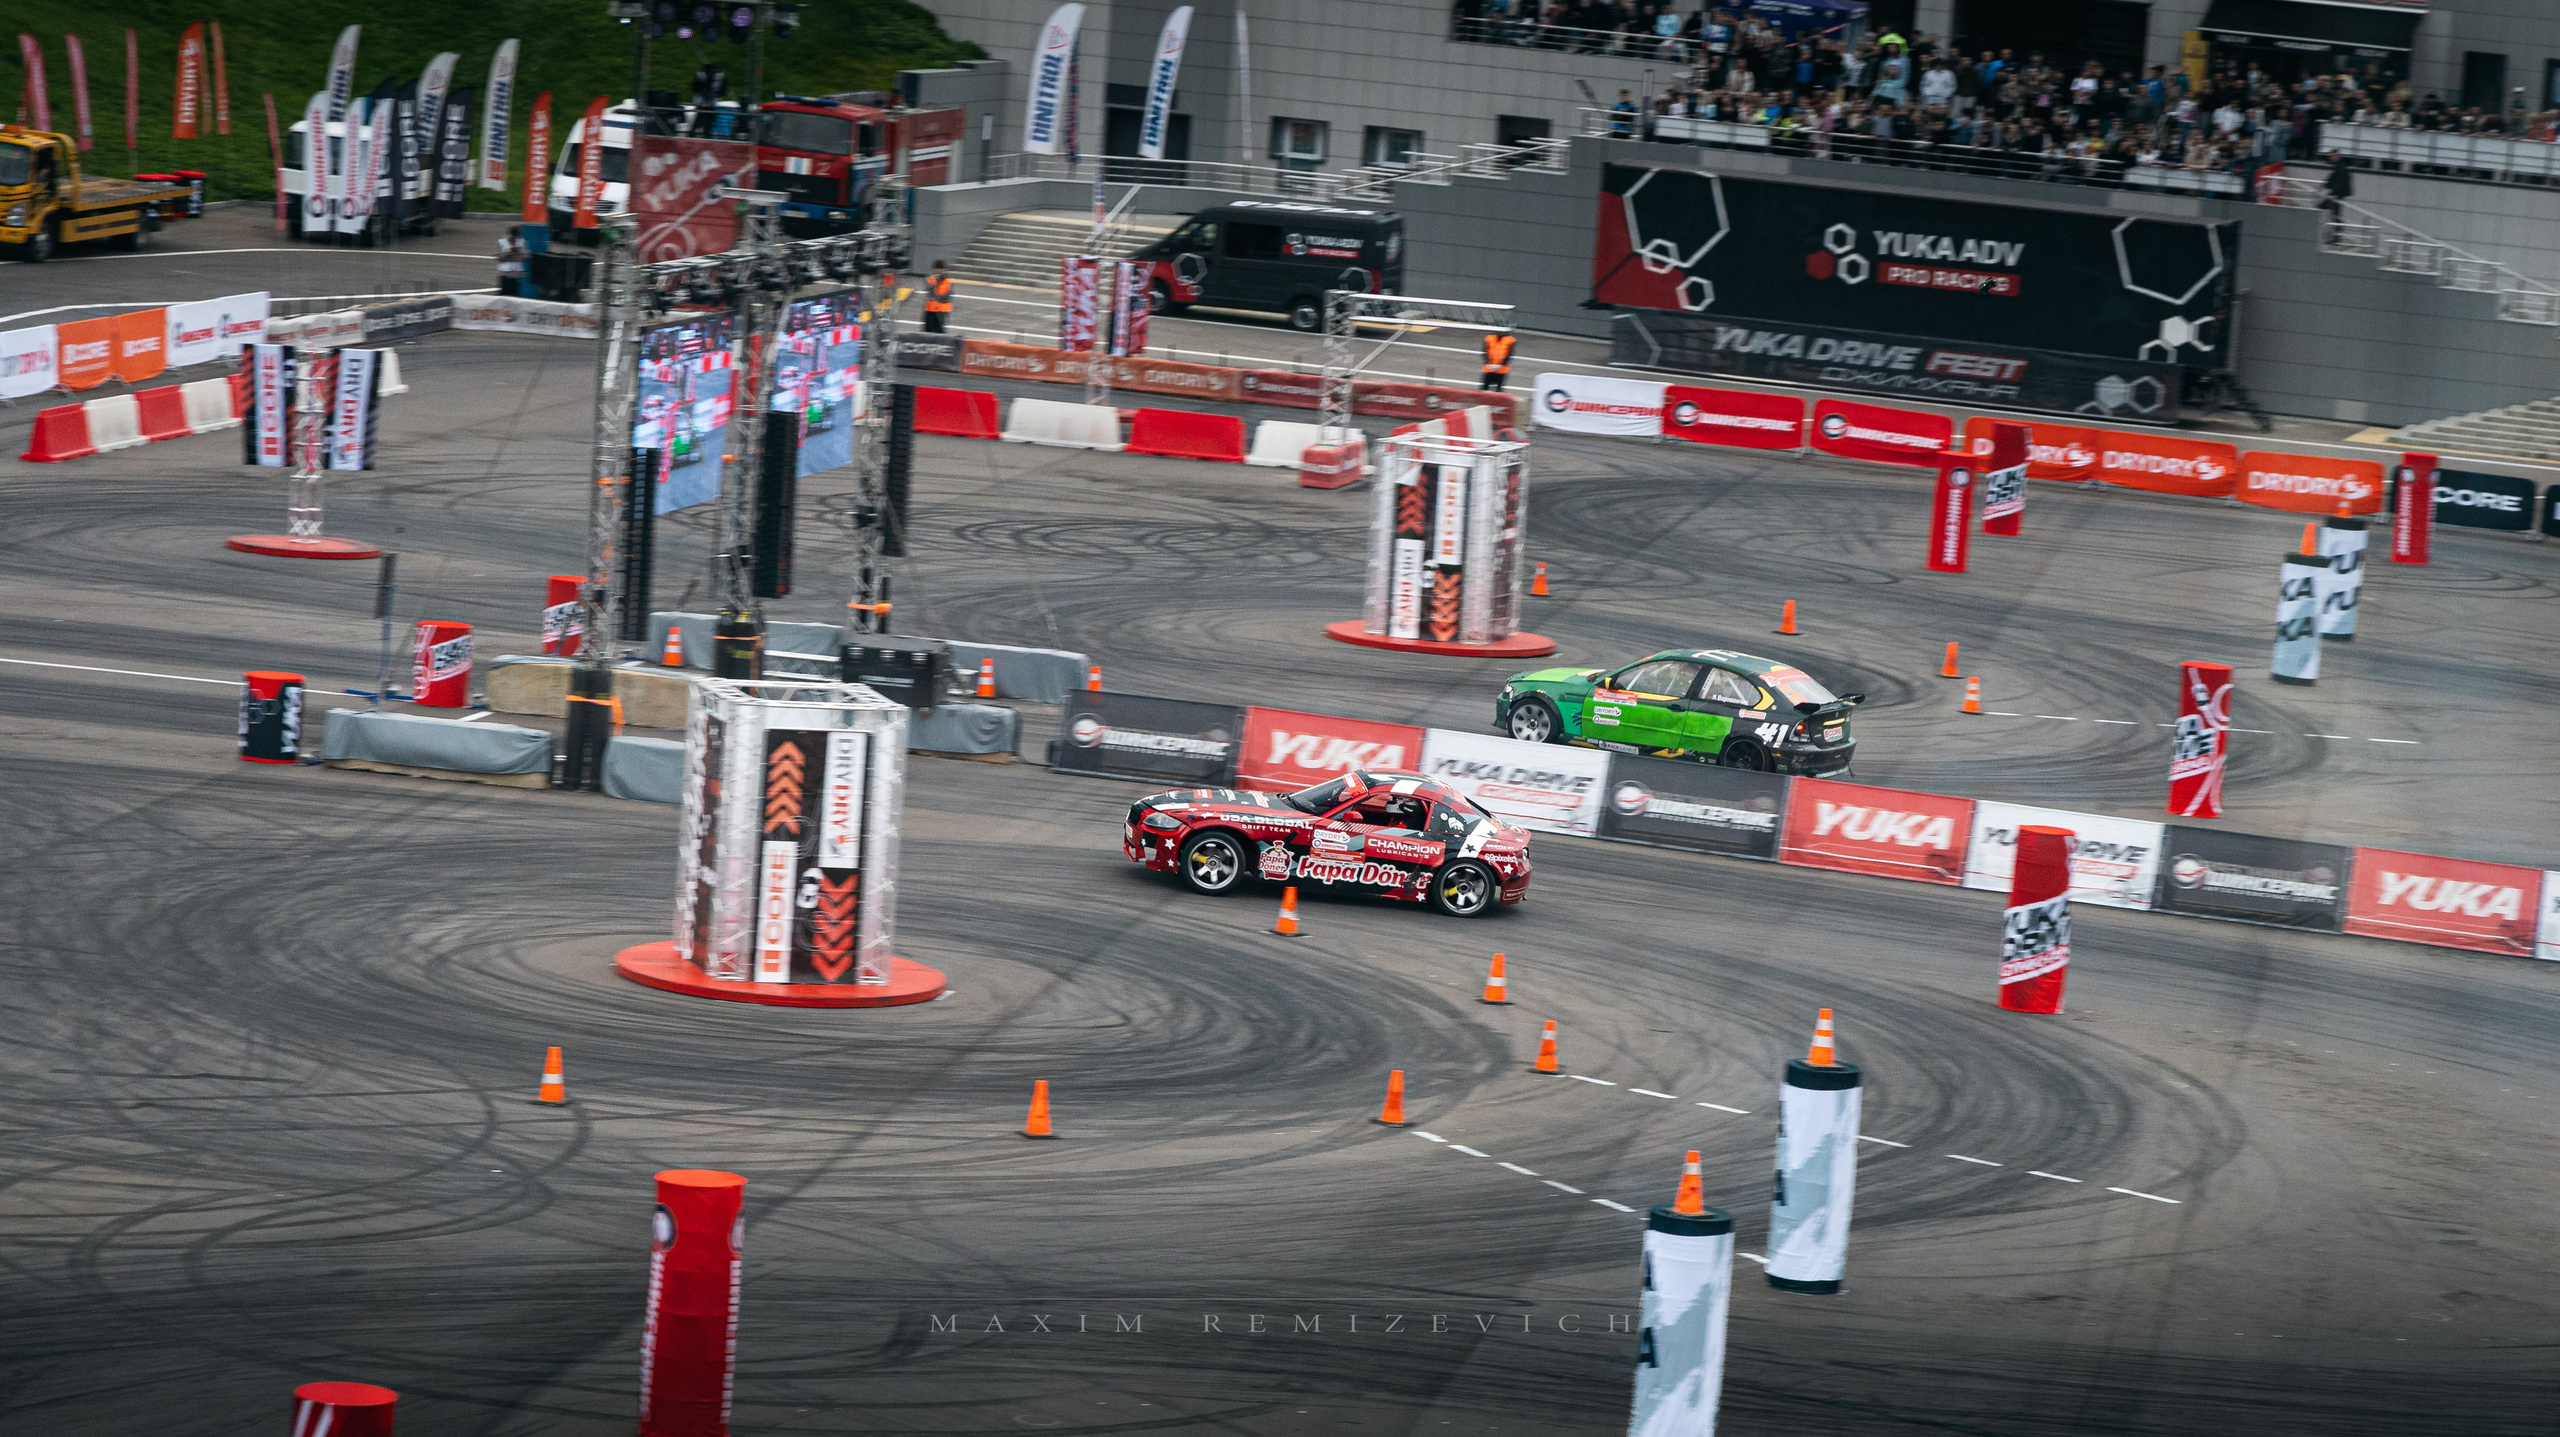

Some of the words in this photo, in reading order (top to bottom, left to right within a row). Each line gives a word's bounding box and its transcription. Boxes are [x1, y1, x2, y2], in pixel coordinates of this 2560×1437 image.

[1031, 54, 1063, 142] DINITROL
[1888, 266, 1931, 285] PRO
[1710, 326, 1806, 359] YUKA
[1804, 337, 1923, 371] DRIVE
[1925, 350, 2028, 380] FEST
[2102, 450, 2198, 477] DRYDRY
[2248, 471, 2341, 495] DRYDRY
[1266, 729, 1405, 772] YUKA
[829, 737, 858, 832] DRYDRY
[1241, 823, 1266, 832] DRIFT
[1268, 826, 1291, 834] TEAM
[1252, 816, 1314, 831] GLOBAL
[1315, 830, 1341, 841] DRYDRY
[1811, 800, 1956, 850] YUKA
[1261, 852, 1285, 864] Papa
[1367, 838, 1441, 855] CHAMPION
[1376, 848, 1430, 859] LUBRICANTS
[1297, 855, 1358, 885] Papa
[2376, 870, 2524, 921] YUKA
